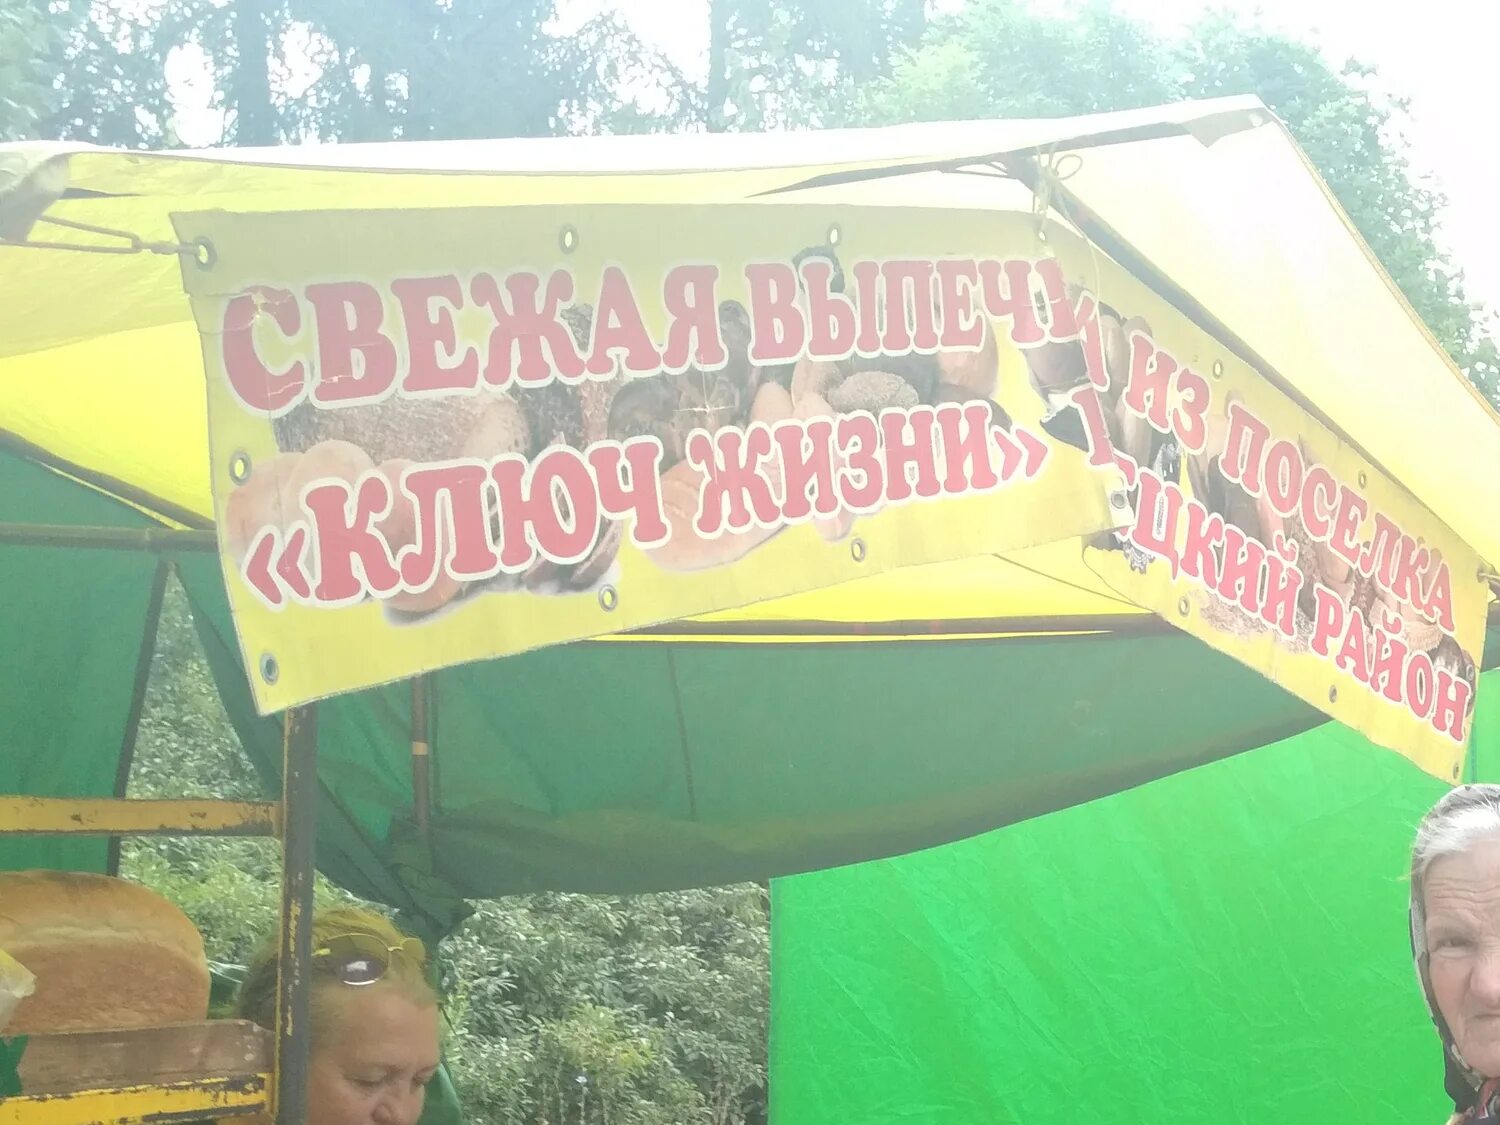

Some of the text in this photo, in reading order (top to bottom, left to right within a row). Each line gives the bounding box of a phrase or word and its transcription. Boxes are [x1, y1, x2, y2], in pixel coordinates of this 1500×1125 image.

[222, 263, 726, 411] СВЕЖАЯ
[1126, 334, 1210, 449] ИЗ
[1221, 403, 1457, 632] ПОСЕЛКА
[244, 440, 669, 605] «КЛЮЧ
[694, 404, 1049, 538] ЖИЗНИ»
[1312, 588, 1473, 743] РАЙОН
